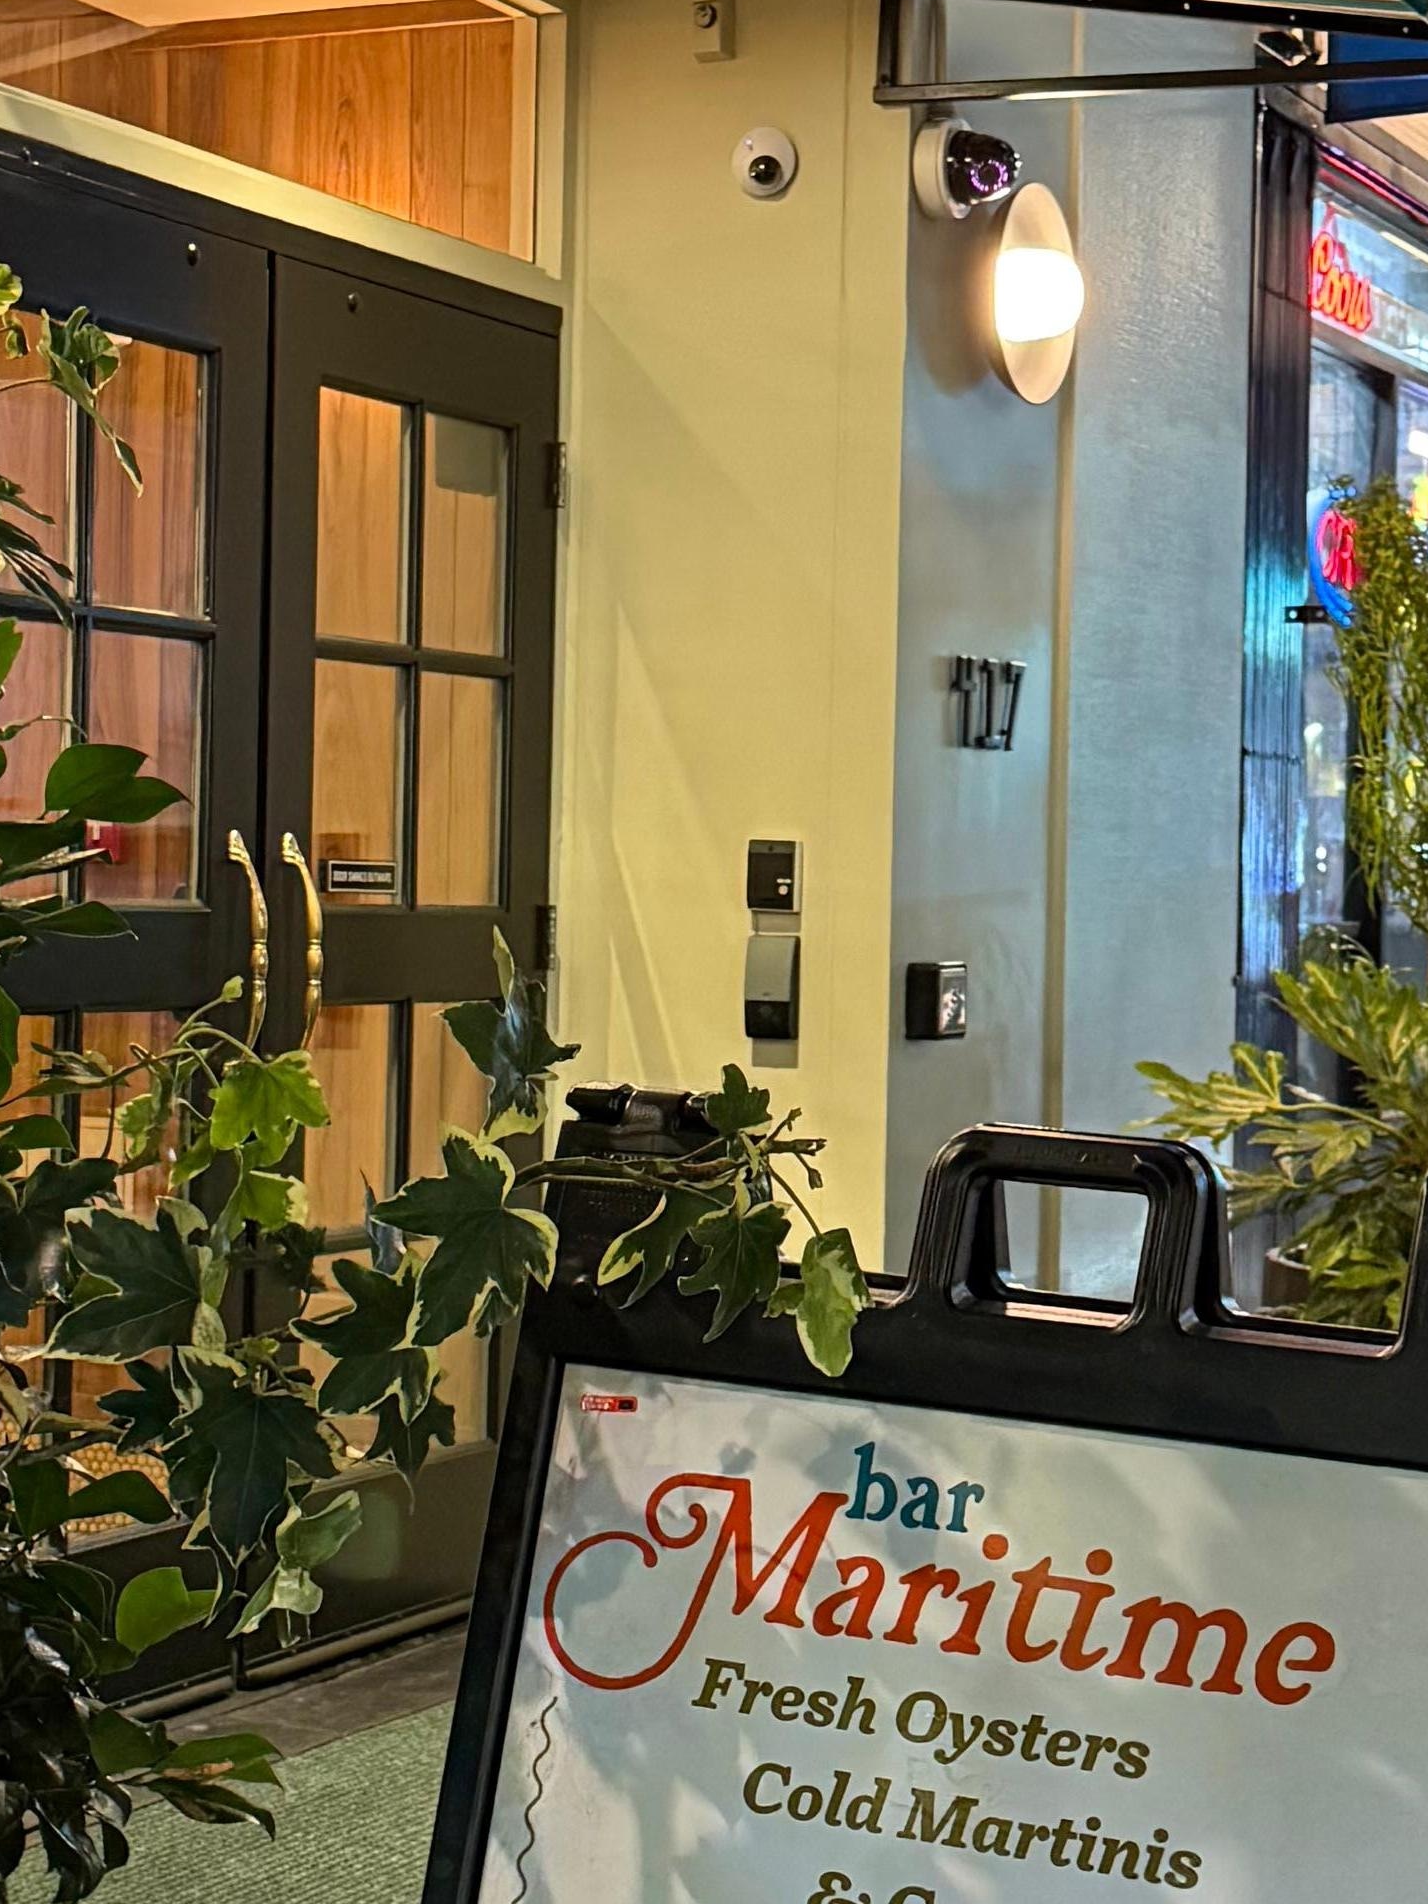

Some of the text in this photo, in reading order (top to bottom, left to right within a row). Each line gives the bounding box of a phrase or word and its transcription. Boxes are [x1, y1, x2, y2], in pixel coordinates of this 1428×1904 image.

[845, 1441, 985, 1535] bar
[542, 1472, 1336, 1708] Maritime
[691, 1657, 1152, 1783] Fresh Oysters
[742, 1762, 1203, 1892] Cold Martinis
